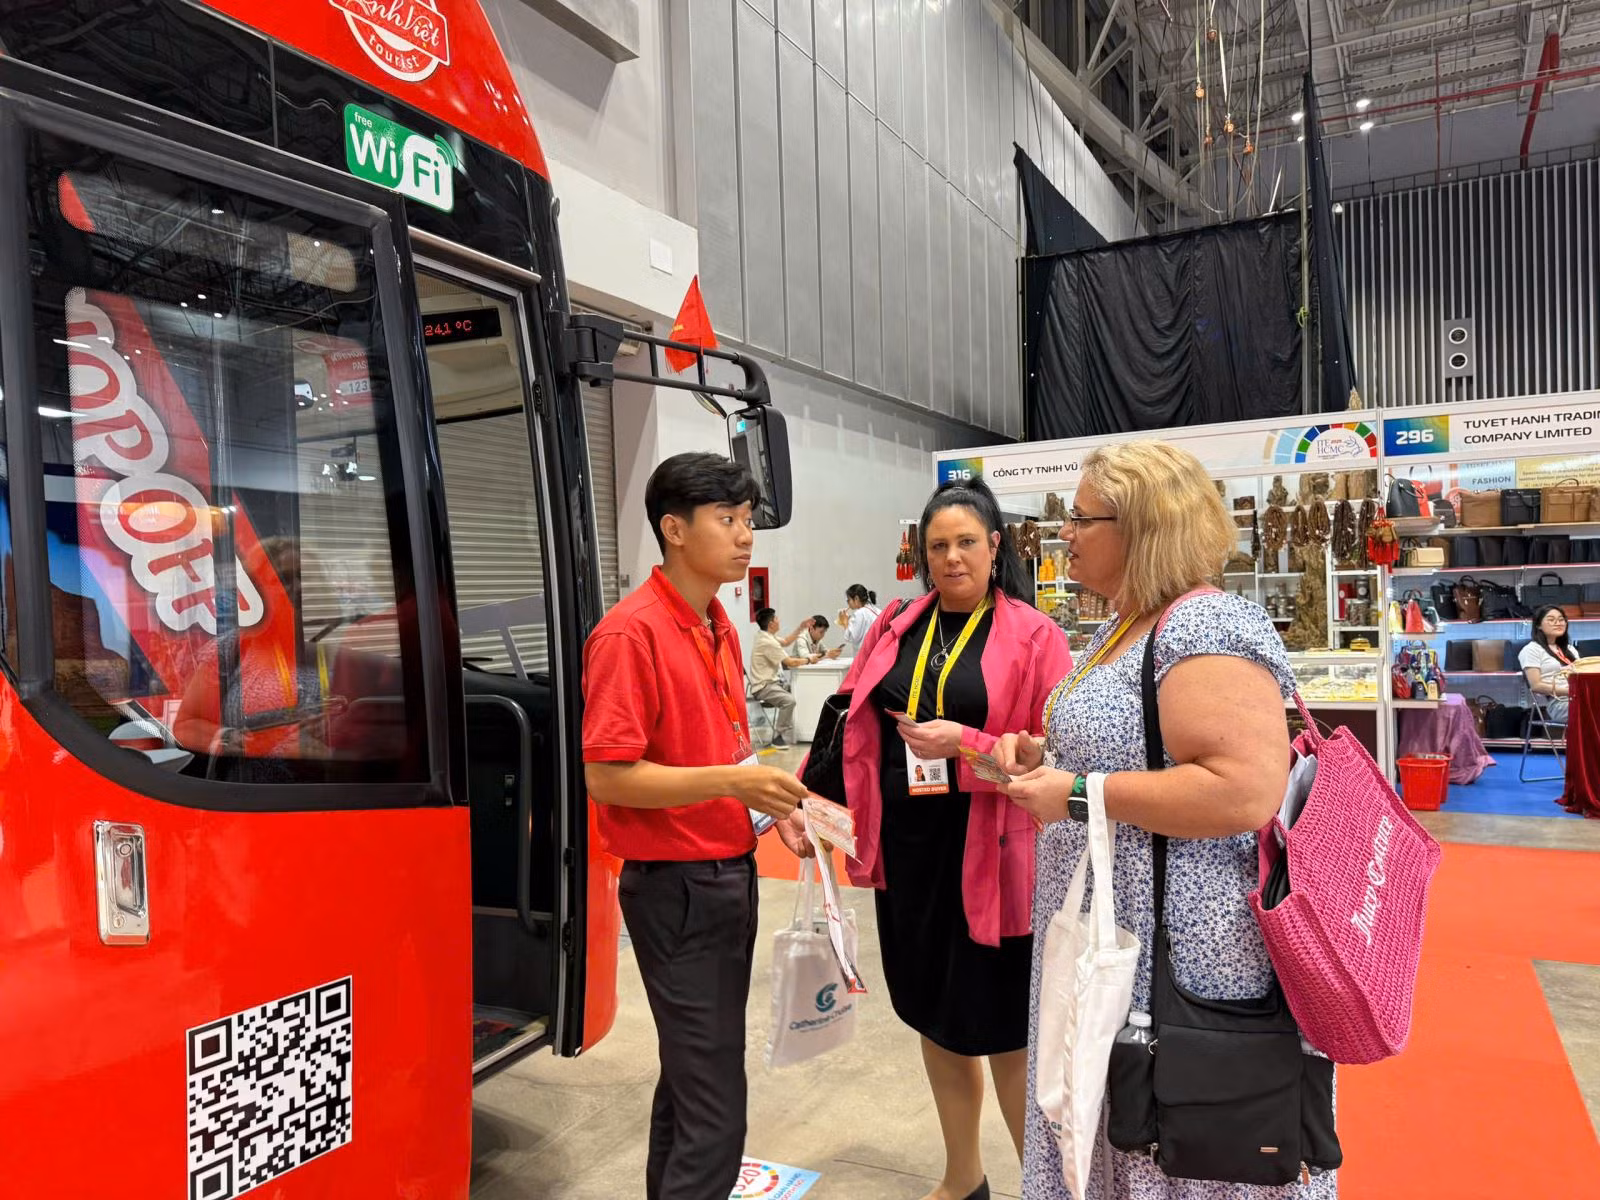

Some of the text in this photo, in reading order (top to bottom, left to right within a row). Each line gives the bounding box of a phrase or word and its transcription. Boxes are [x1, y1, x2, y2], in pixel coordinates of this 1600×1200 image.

[369, 34, 420, 69] tourist
[354, 112, 372, 128] free
[349, 380, 368, 392] 123
[1464, 418, 1508, 429] TUYET
[1511, 414, 1551, 426] HANH
[1395, 428, 1434, 446] 296
[1464, 426, 1592, 444] COMPANY LIMITED
[947, 469, 971, 481] 316
[993, 462, 1078, 477] CÔNG TY TNHH VŨ
[1472, 475, 1511, 485] FASHION
